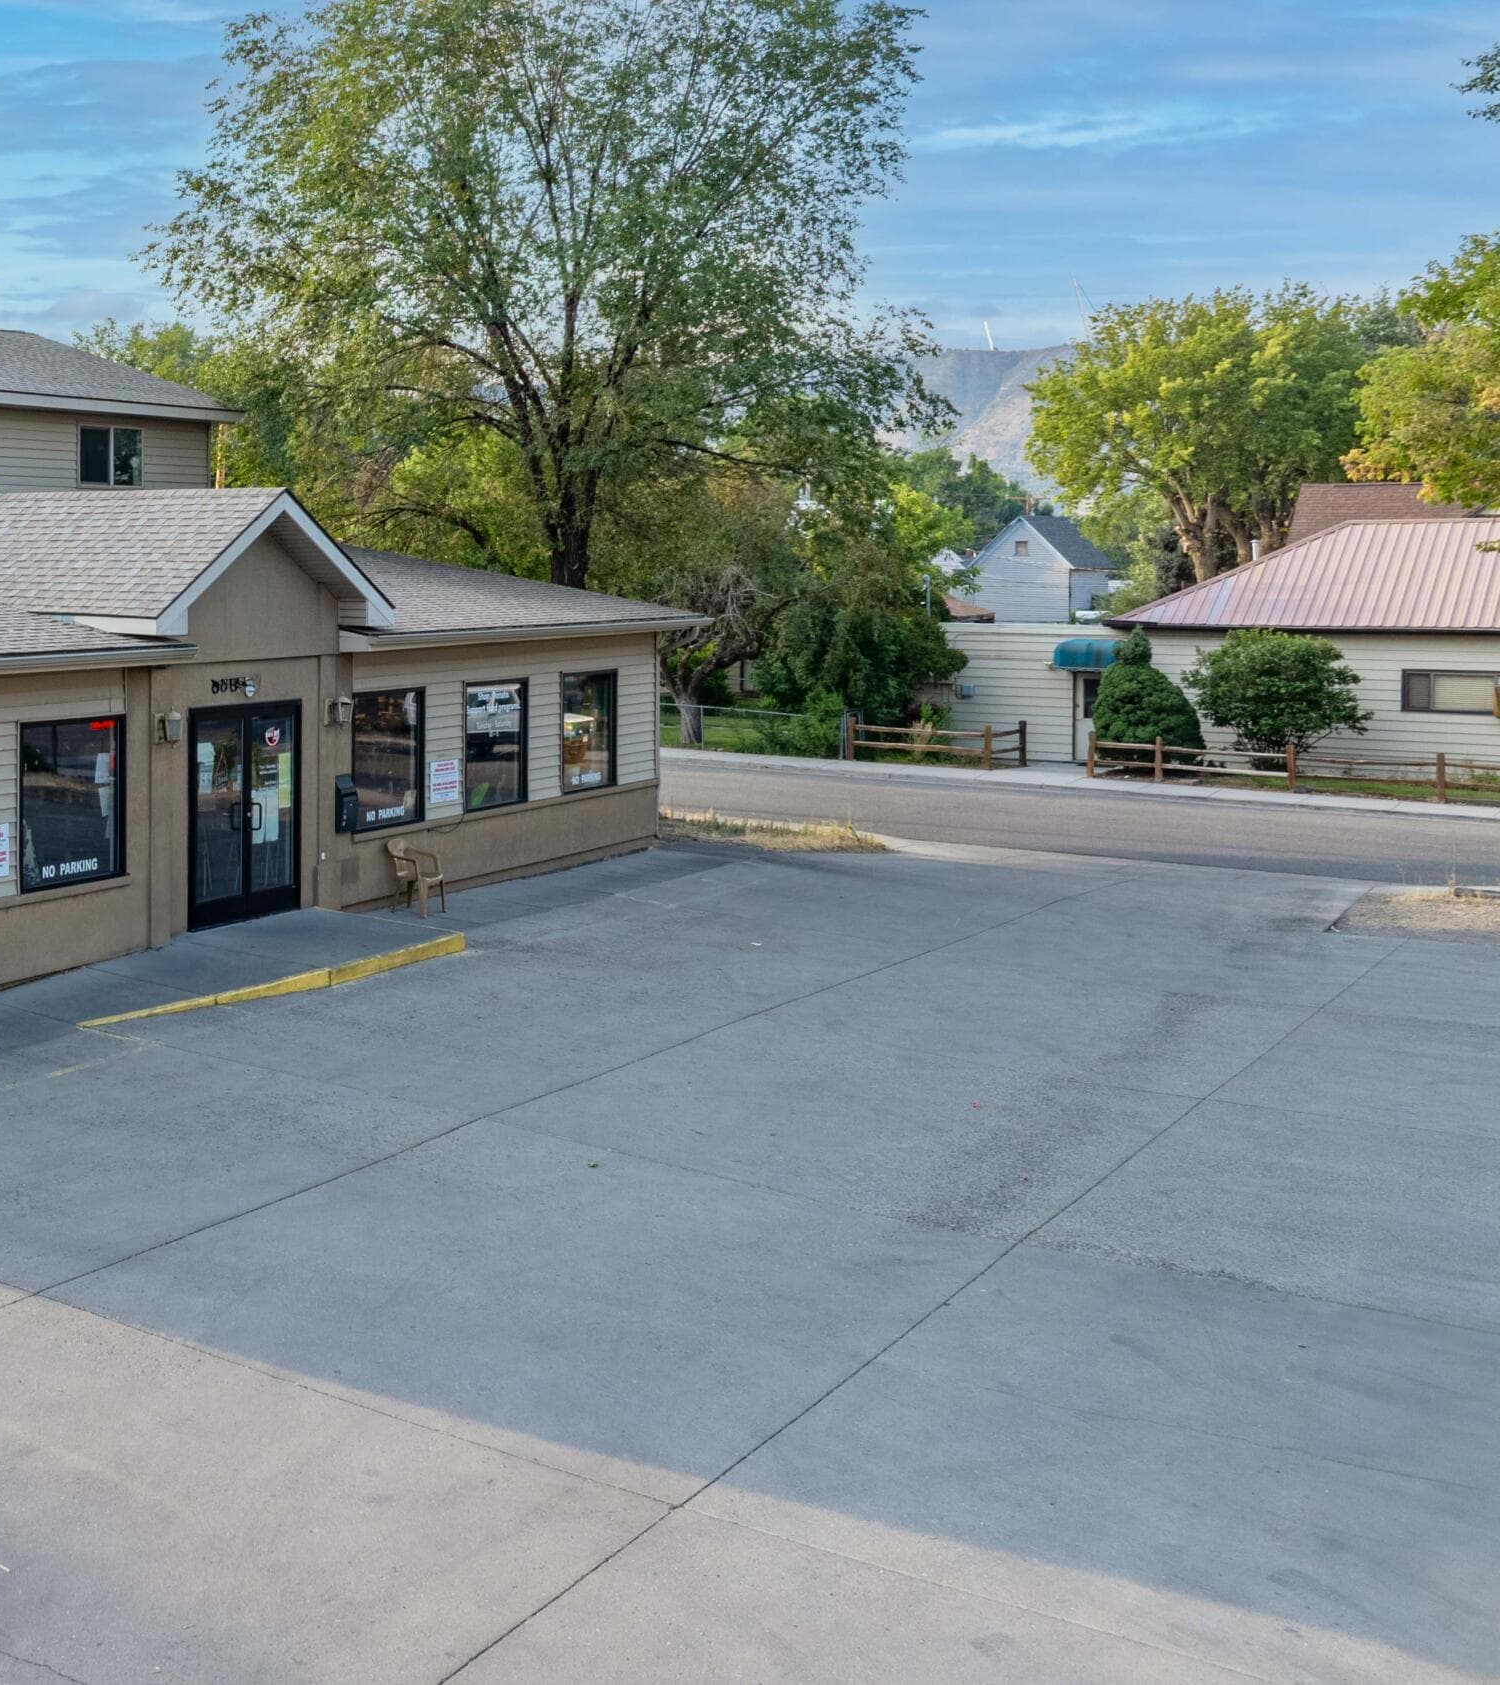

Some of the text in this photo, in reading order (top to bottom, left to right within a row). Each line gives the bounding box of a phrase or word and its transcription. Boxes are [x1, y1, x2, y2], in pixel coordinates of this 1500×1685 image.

[366, 805, 405, 822] NO PARKING
[42, 857, 98, 879] NO PARKING
